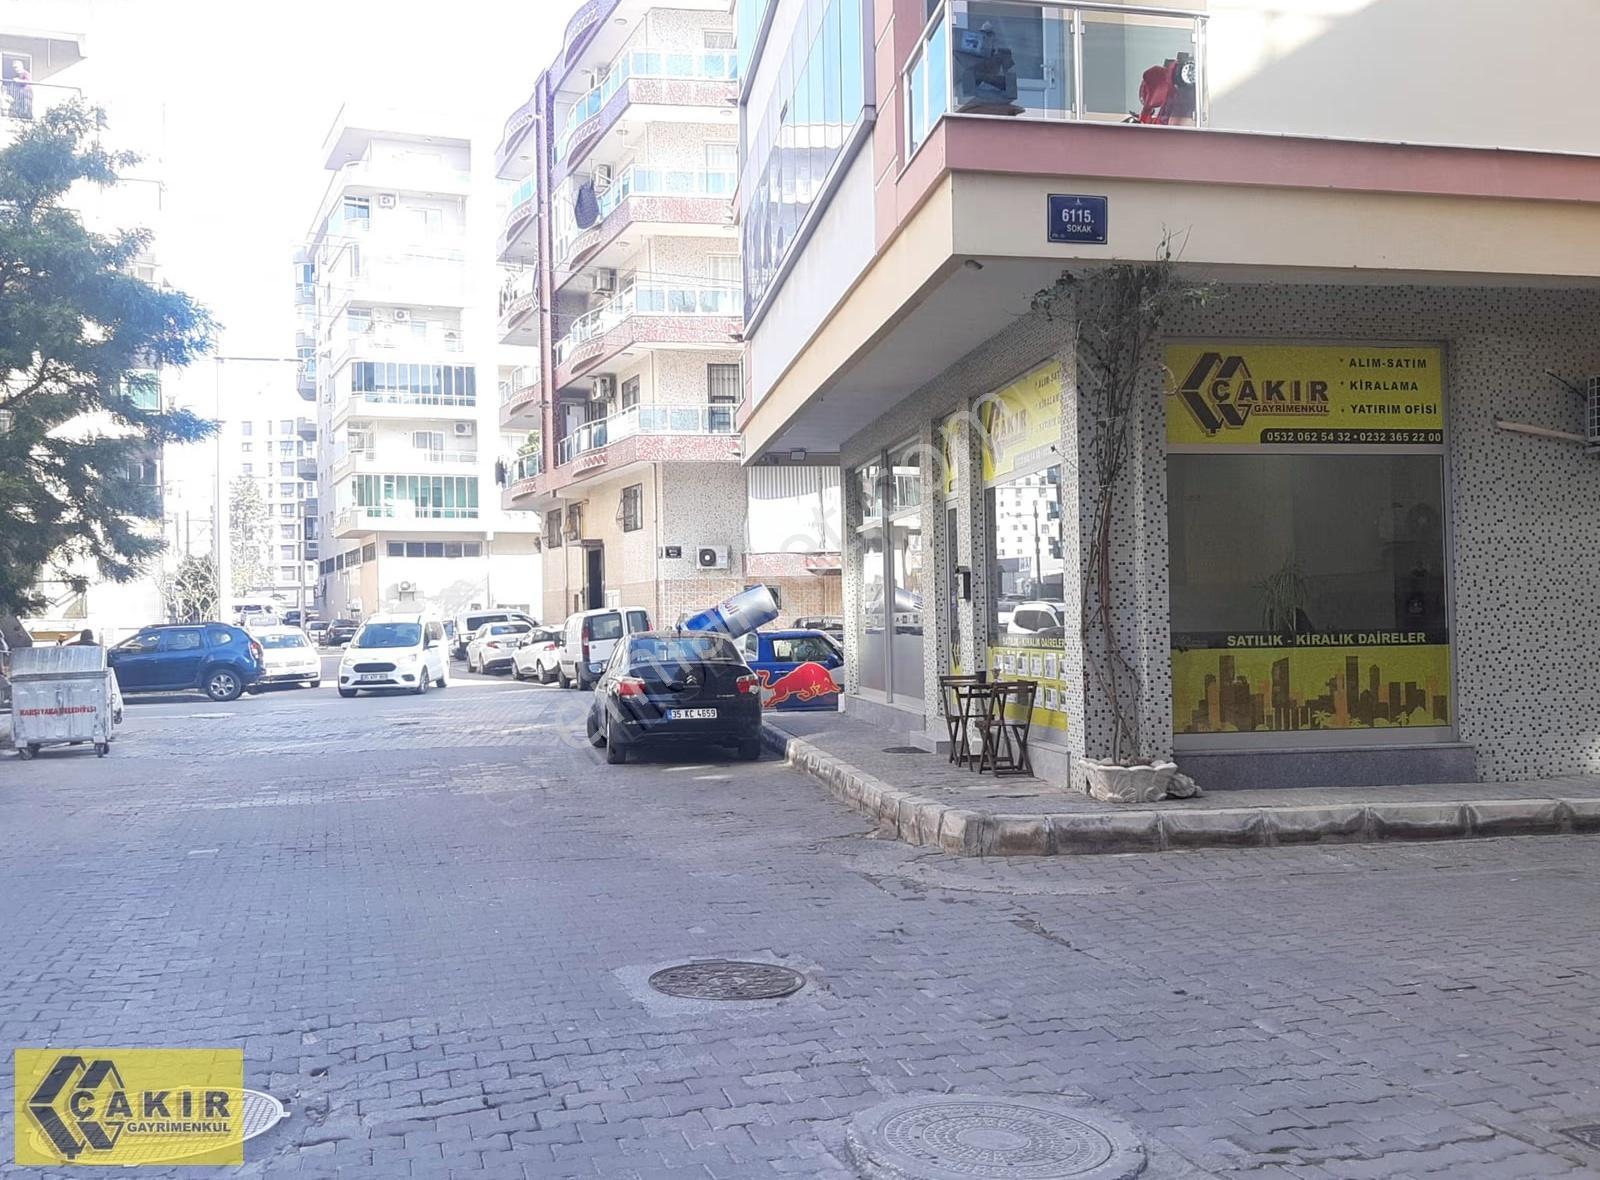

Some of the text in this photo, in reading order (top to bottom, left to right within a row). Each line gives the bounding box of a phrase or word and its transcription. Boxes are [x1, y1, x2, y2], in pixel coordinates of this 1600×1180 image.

[1062, 208, 1094, 223] 6115.
[1066, 224, 1092, 233] SOKAK
[1349, 358, 1427, 368] ALIM-SATIM
[1349, 379, 1418, 391] KİRALAMA
[1211, 380, 1329, 403] ÇAKIR
[1254, 402, 1330, 413] GAYRİMENKUL
[1350, 402, 1437, 415] YATIRIM OFİSİ
[1267, 432, 1441, 442] 0532 062 54 32 0232 365 22 00
[1227, 634, 1283, 647] SATILIK
[1296, 632, 1354, 645] KİRALIK
[1358, 631, 1426, 645] DAİRELER
[672, 709, 717, 719] 35 KC 4659
